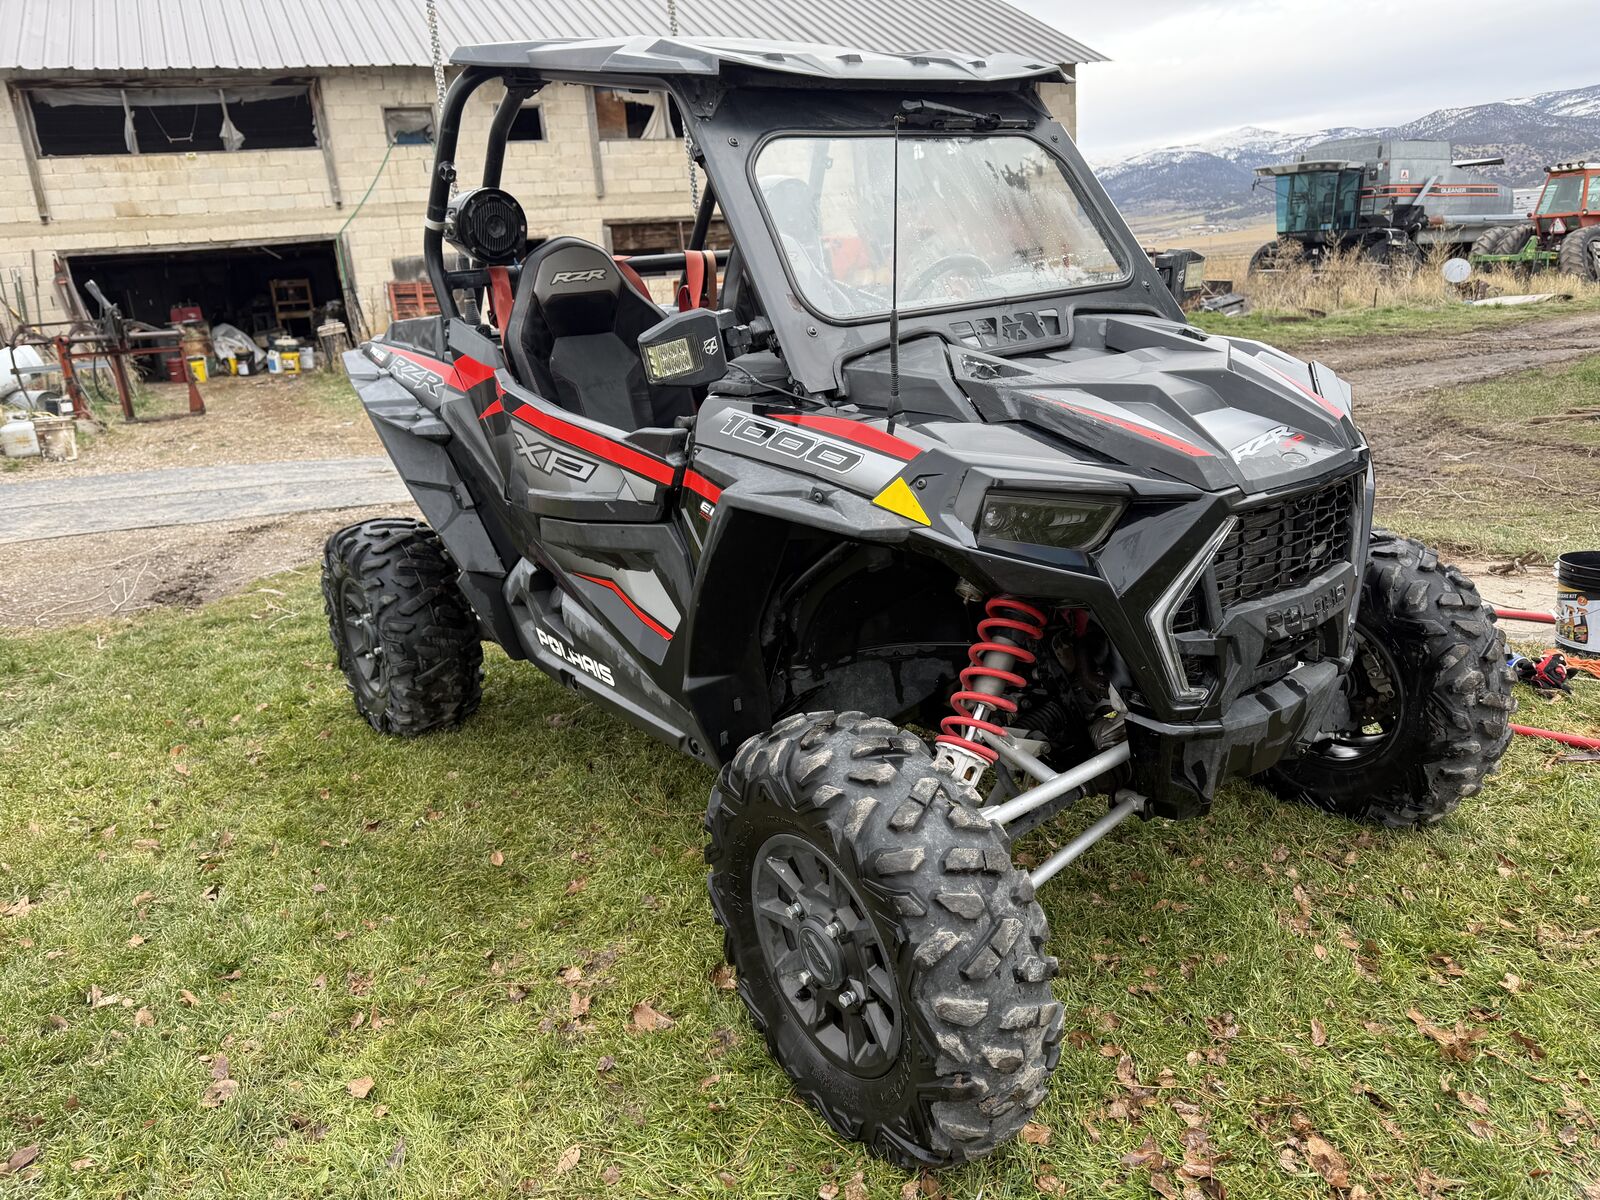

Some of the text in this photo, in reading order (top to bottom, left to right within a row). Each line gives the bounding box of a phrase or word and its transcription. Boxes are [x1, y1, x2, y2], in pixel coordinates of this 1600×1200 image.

[1440, 186, 1467, 194] GLEANER
[551, 269, 607, 285] RZR
[389, 354, 445, 399] RZR
[513, 430, 600, 483] XP
[720, 412, 865, 474] 1000
[1230, 424, 1295, 466] RZR
[1265, 580, 1347, 641] POLARIS
[535, 626, 616, 687] POLARIS
